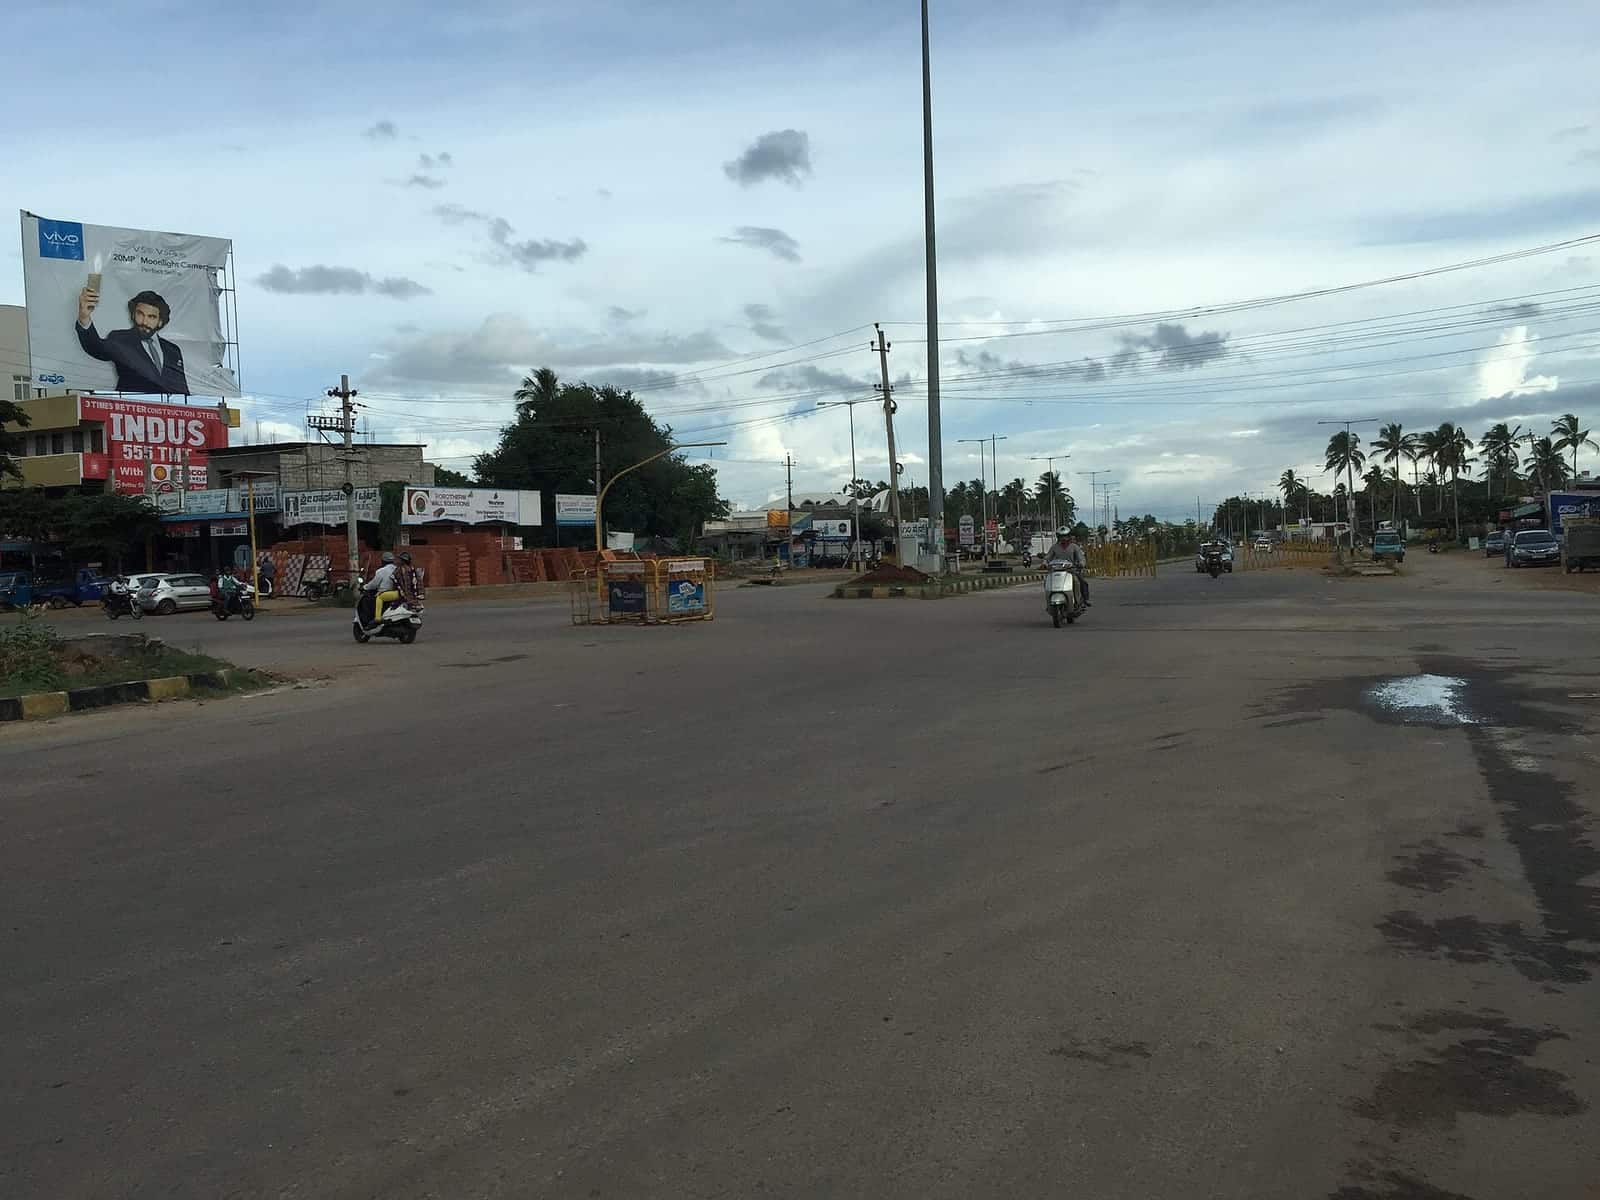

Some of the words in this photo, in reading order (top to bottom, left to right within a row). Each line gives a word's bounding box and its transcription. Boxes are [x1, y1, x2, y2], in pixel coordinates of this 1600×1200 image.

[43, 231, 79, 244] vivo
[113, 252, 136, 263] 20MP
[140, 256, 179, 269] Moonlight
[91, 400, 114, 410] TIMES
[115, 402, 147, 414] BETTER
[147, 407, 195, 418] CONSTRUCTION
[196, 412, 220, 420] STEEL
[110, 412, 206, 447] INDUS
[122, 444, 153, 460] 555
